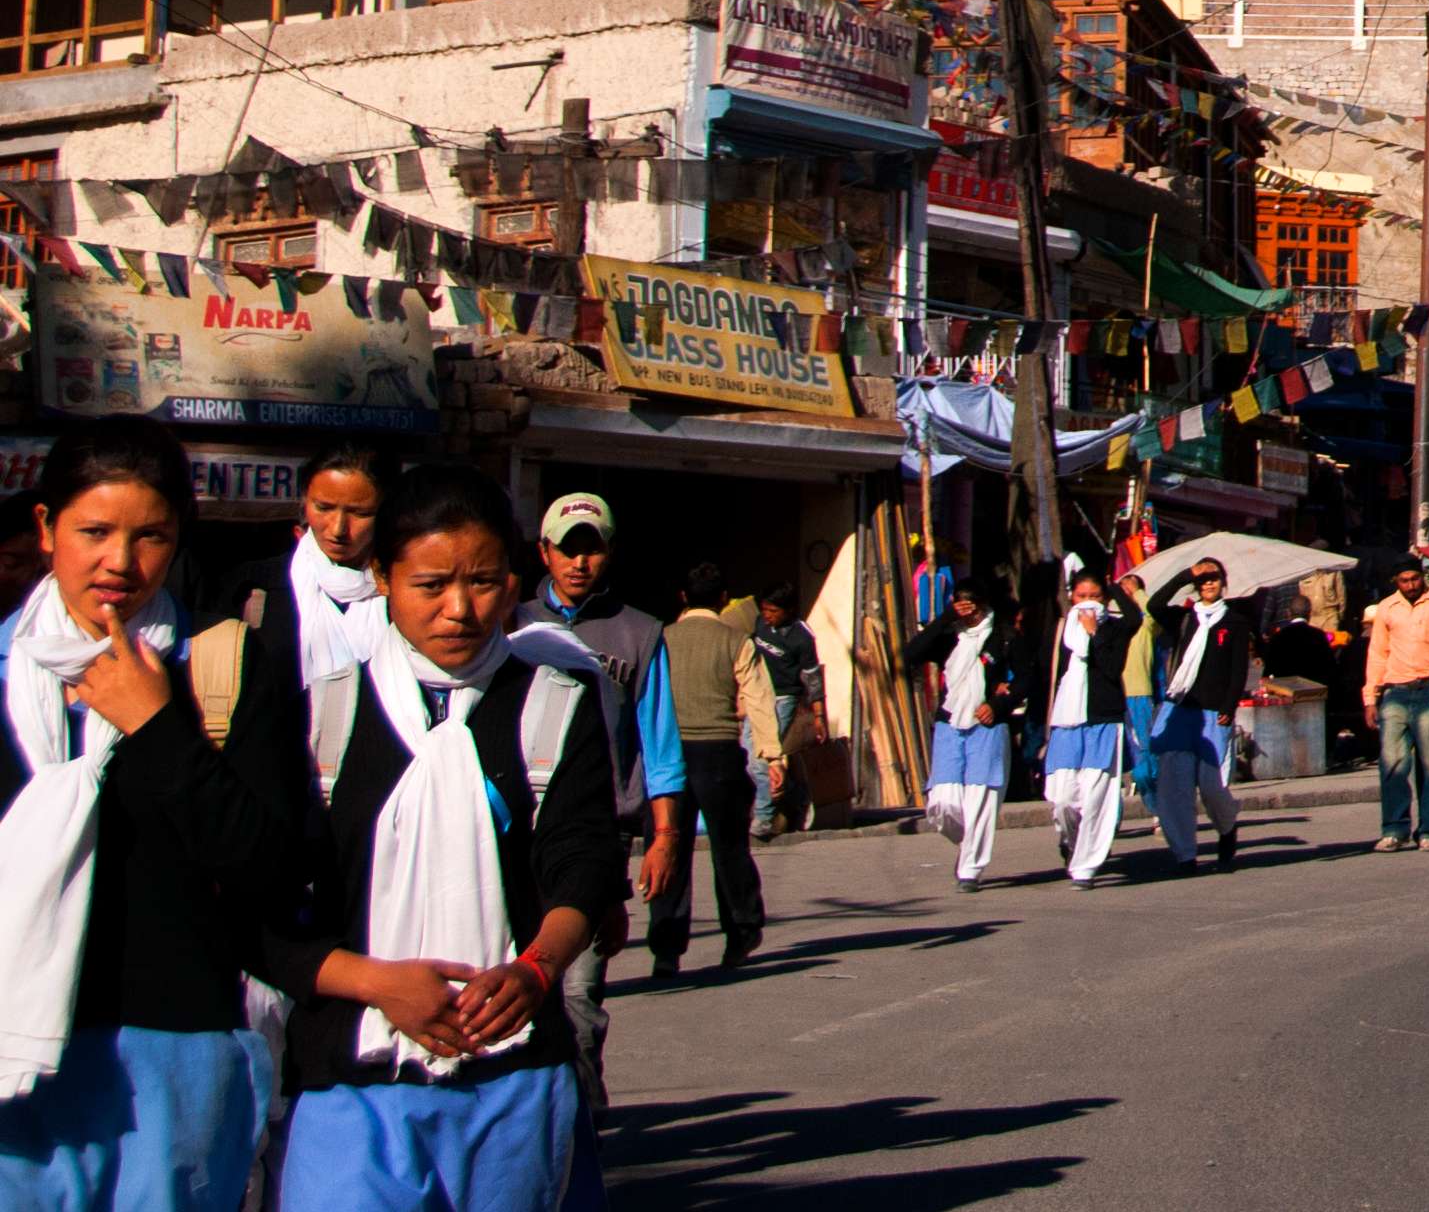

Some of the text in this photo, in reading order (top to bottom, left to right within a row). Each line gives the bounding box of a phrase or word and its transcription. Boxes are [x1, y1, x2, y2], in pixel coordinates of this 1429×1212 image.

[813, 15, 912, 60] HANDICRAFT
[657, 369, 682, 385] NEW
[688, 372, 712, 388] BUS
[735, 342, 829, 387] HOUSE
[173, 398, 247, 422] SHARMA
[192, 461, 302, 499] ENTER
